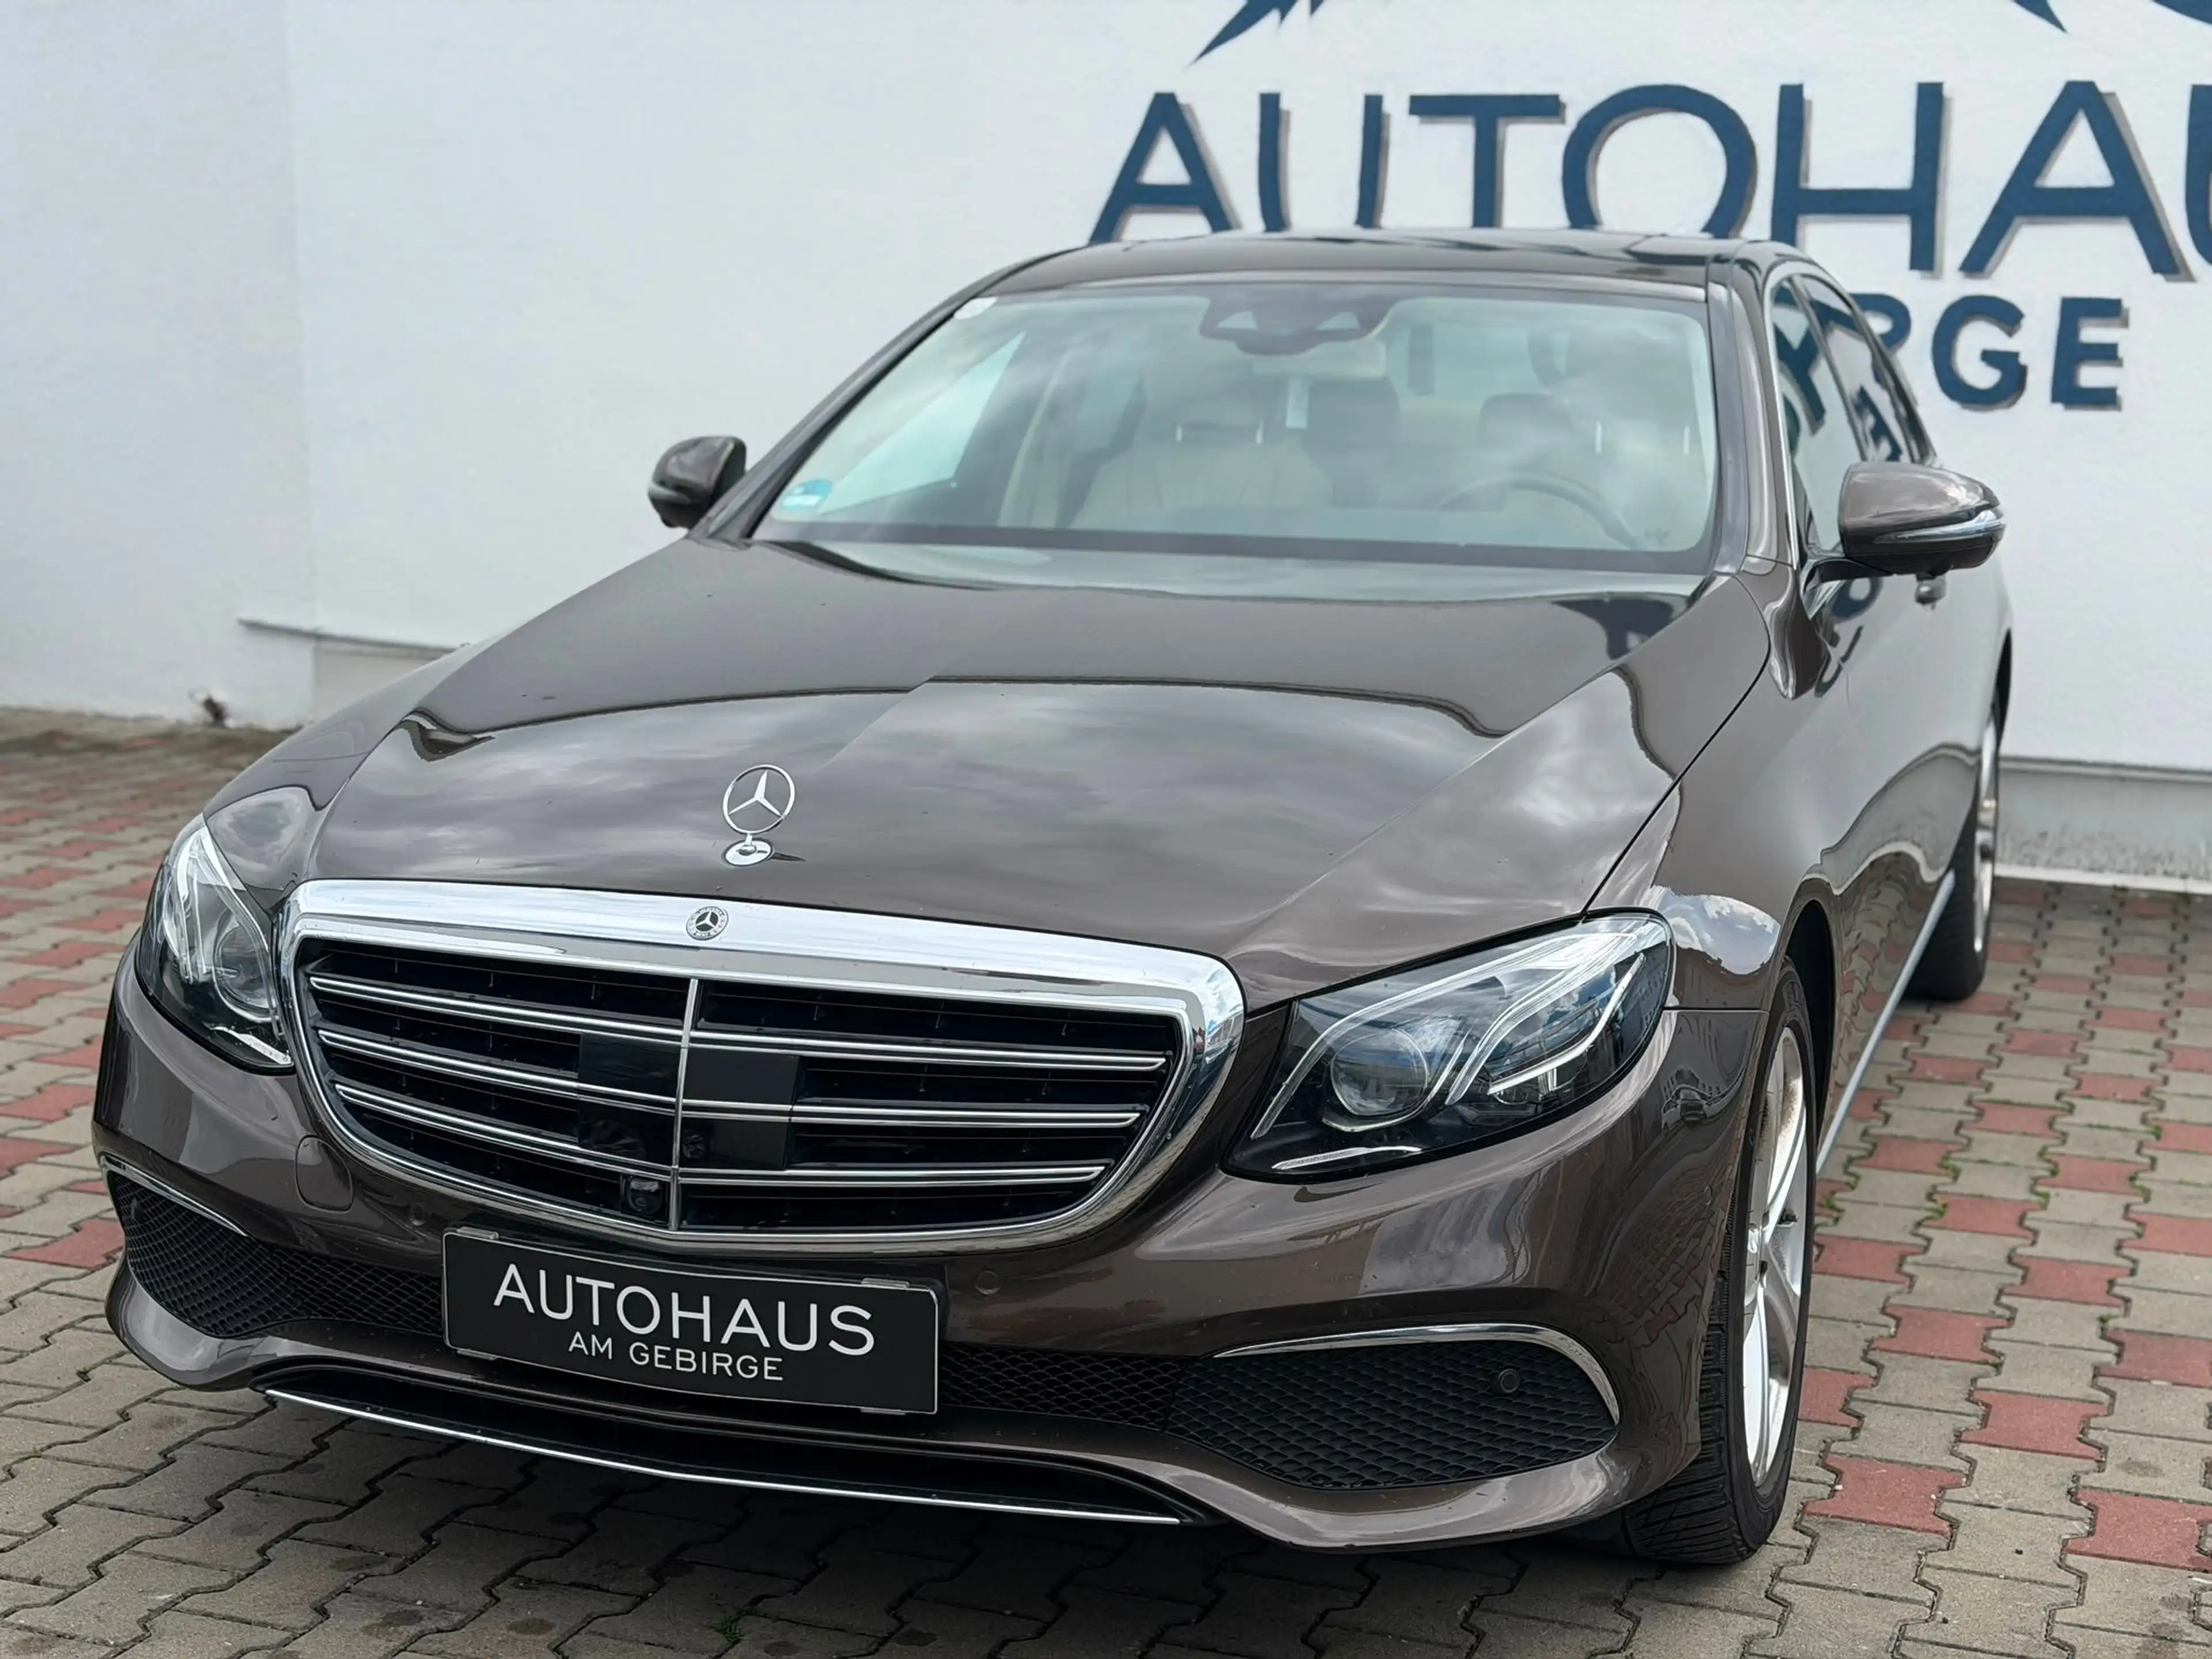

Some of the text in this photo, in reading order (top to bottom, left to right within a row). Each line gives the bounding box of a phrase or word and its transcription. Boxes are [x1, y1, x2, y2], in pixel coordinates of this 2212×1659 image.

[1090, 82, 2212, 274] AUTOHA
[493, 1263, 875, 1356] AUTOHAUS
[568, 1331, 783, 1381] AM GEBIRGE
